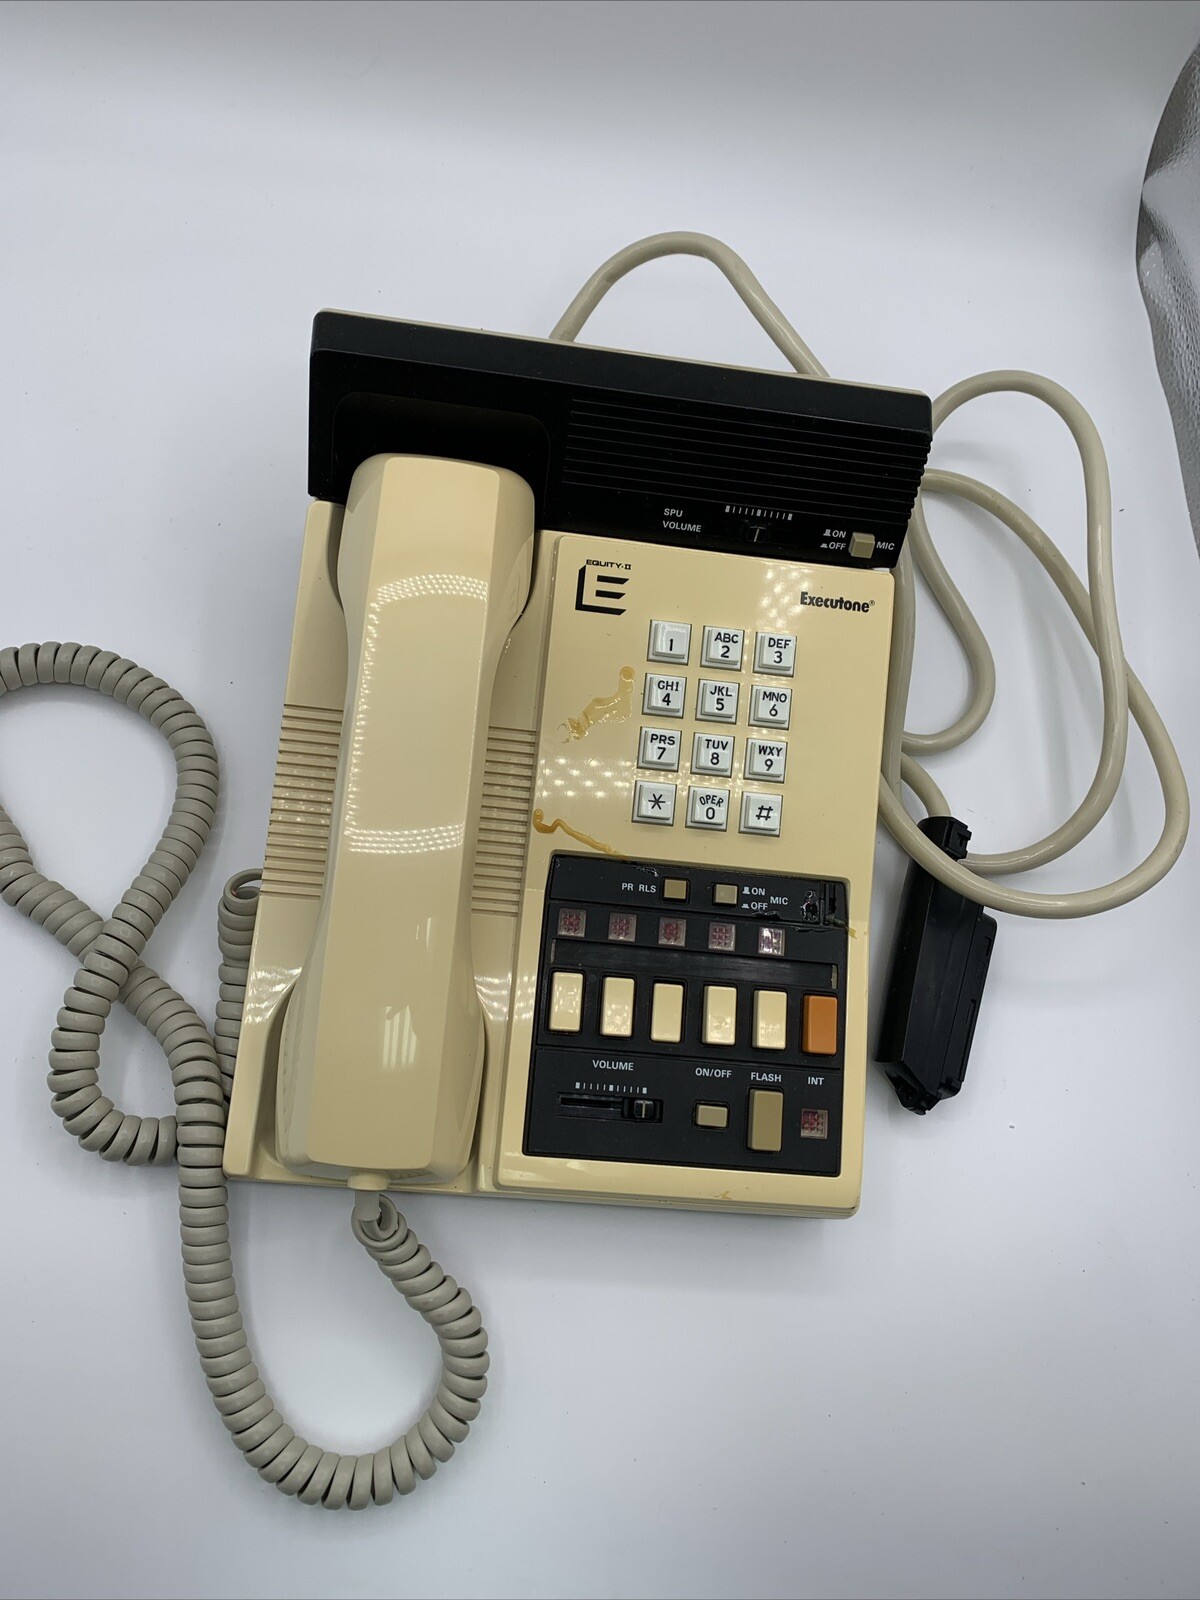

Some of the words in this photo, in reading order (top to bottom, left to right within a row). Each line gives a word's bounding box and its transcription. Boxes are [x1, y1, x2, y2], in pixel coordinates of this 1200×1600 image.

[663, 507, 684, 518] SPU
[662, 520, 702, 533] VOLUME
[831, 529, 847, 539] ON
[828, 541, 847, 551] OFF
[876, 541, 895, 551] MIC
[714, 631, 739, 644] ABC
[767, 636, 792, 650] DEF
[668, 638, 674, 652] 1
[720, 645, 730, 659] 2
[773, 650, 783, 664] 3
[657, 680, 680, 692] GHI
[709, 685, 733, 697] JKL
[661, 693, 672, 706] 4
[762, 691, 788, 704] MNO
[715, 698, 725, 711] 5
[769, 704, 778, 717] 6
[649, 733, 676, 746] PRS
[704, 738, 729, 751] TUV
[657, 746, 667, 760] 7
[758, 745, 783, 757] WXY
[710, 752, 720, 766] 8
[764, 758, 774, 771] 9
[699, 795, 724, 808] OPER
[705, 807, 715, 820] 0
[755, 805, 774, 821] #
[621, 882, 634, 892] PR
[638, 884, 657, 894] RLS
[751, 887, 766, 897] ON
[750, 902, 768, 911] OFF
[769, 896, 789, 906] MIC
[592, 1059, 634, 1071] VOLUME
[695, 1067, 732, 1079] ON/OFF
[750, 1071, 782, 1083] FLASH
[807, 1076, 825, 1086] INT
